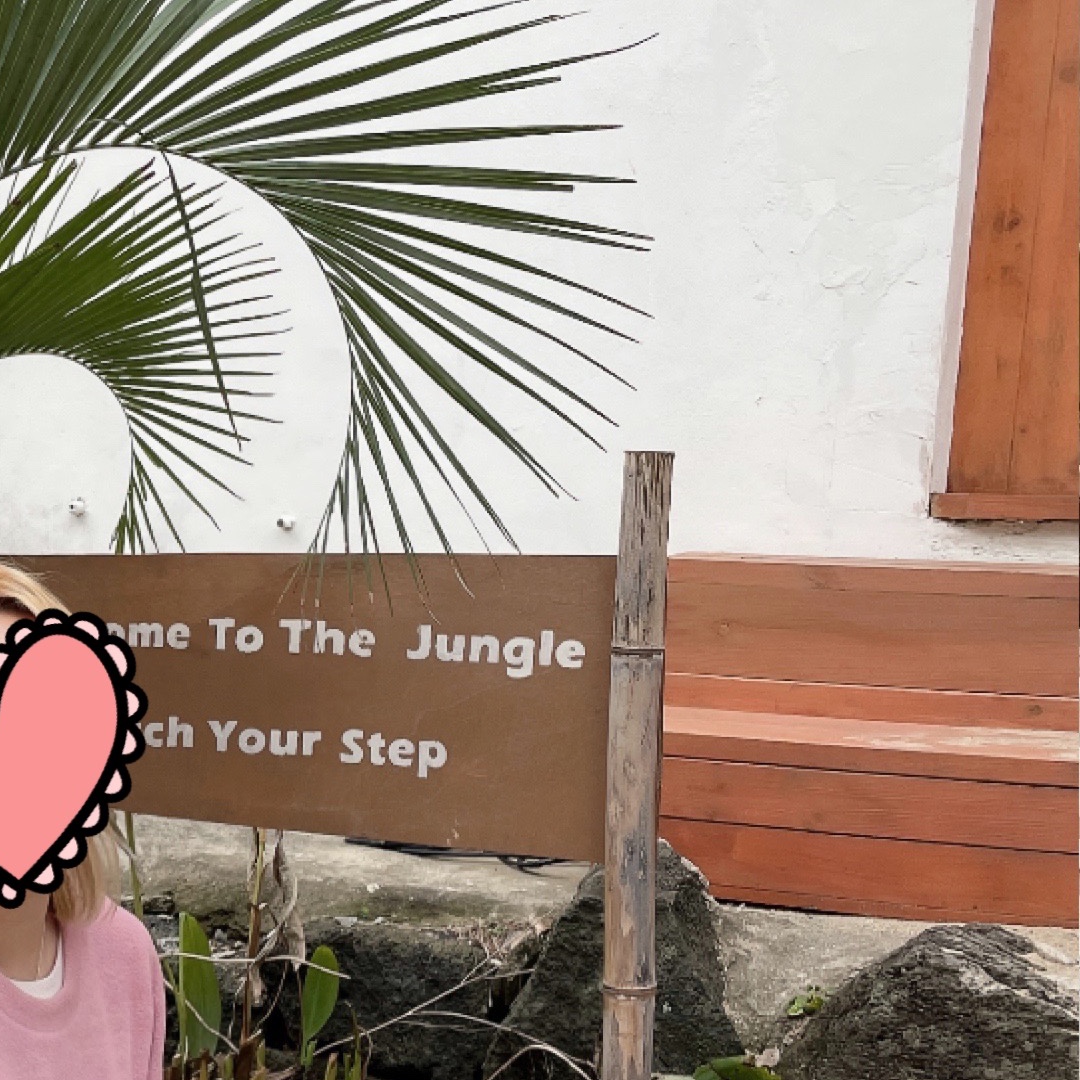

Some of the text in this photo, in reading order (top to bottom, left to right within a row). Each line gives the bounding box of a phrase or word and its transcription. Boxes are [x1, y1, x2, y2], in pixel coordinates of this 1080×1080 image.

[208, 618, 264, 653] To
[279, 618, 376, 658] The
[406, 624, 586, 679] Jungle
[136, 715, 448, 778] ch Your Step
